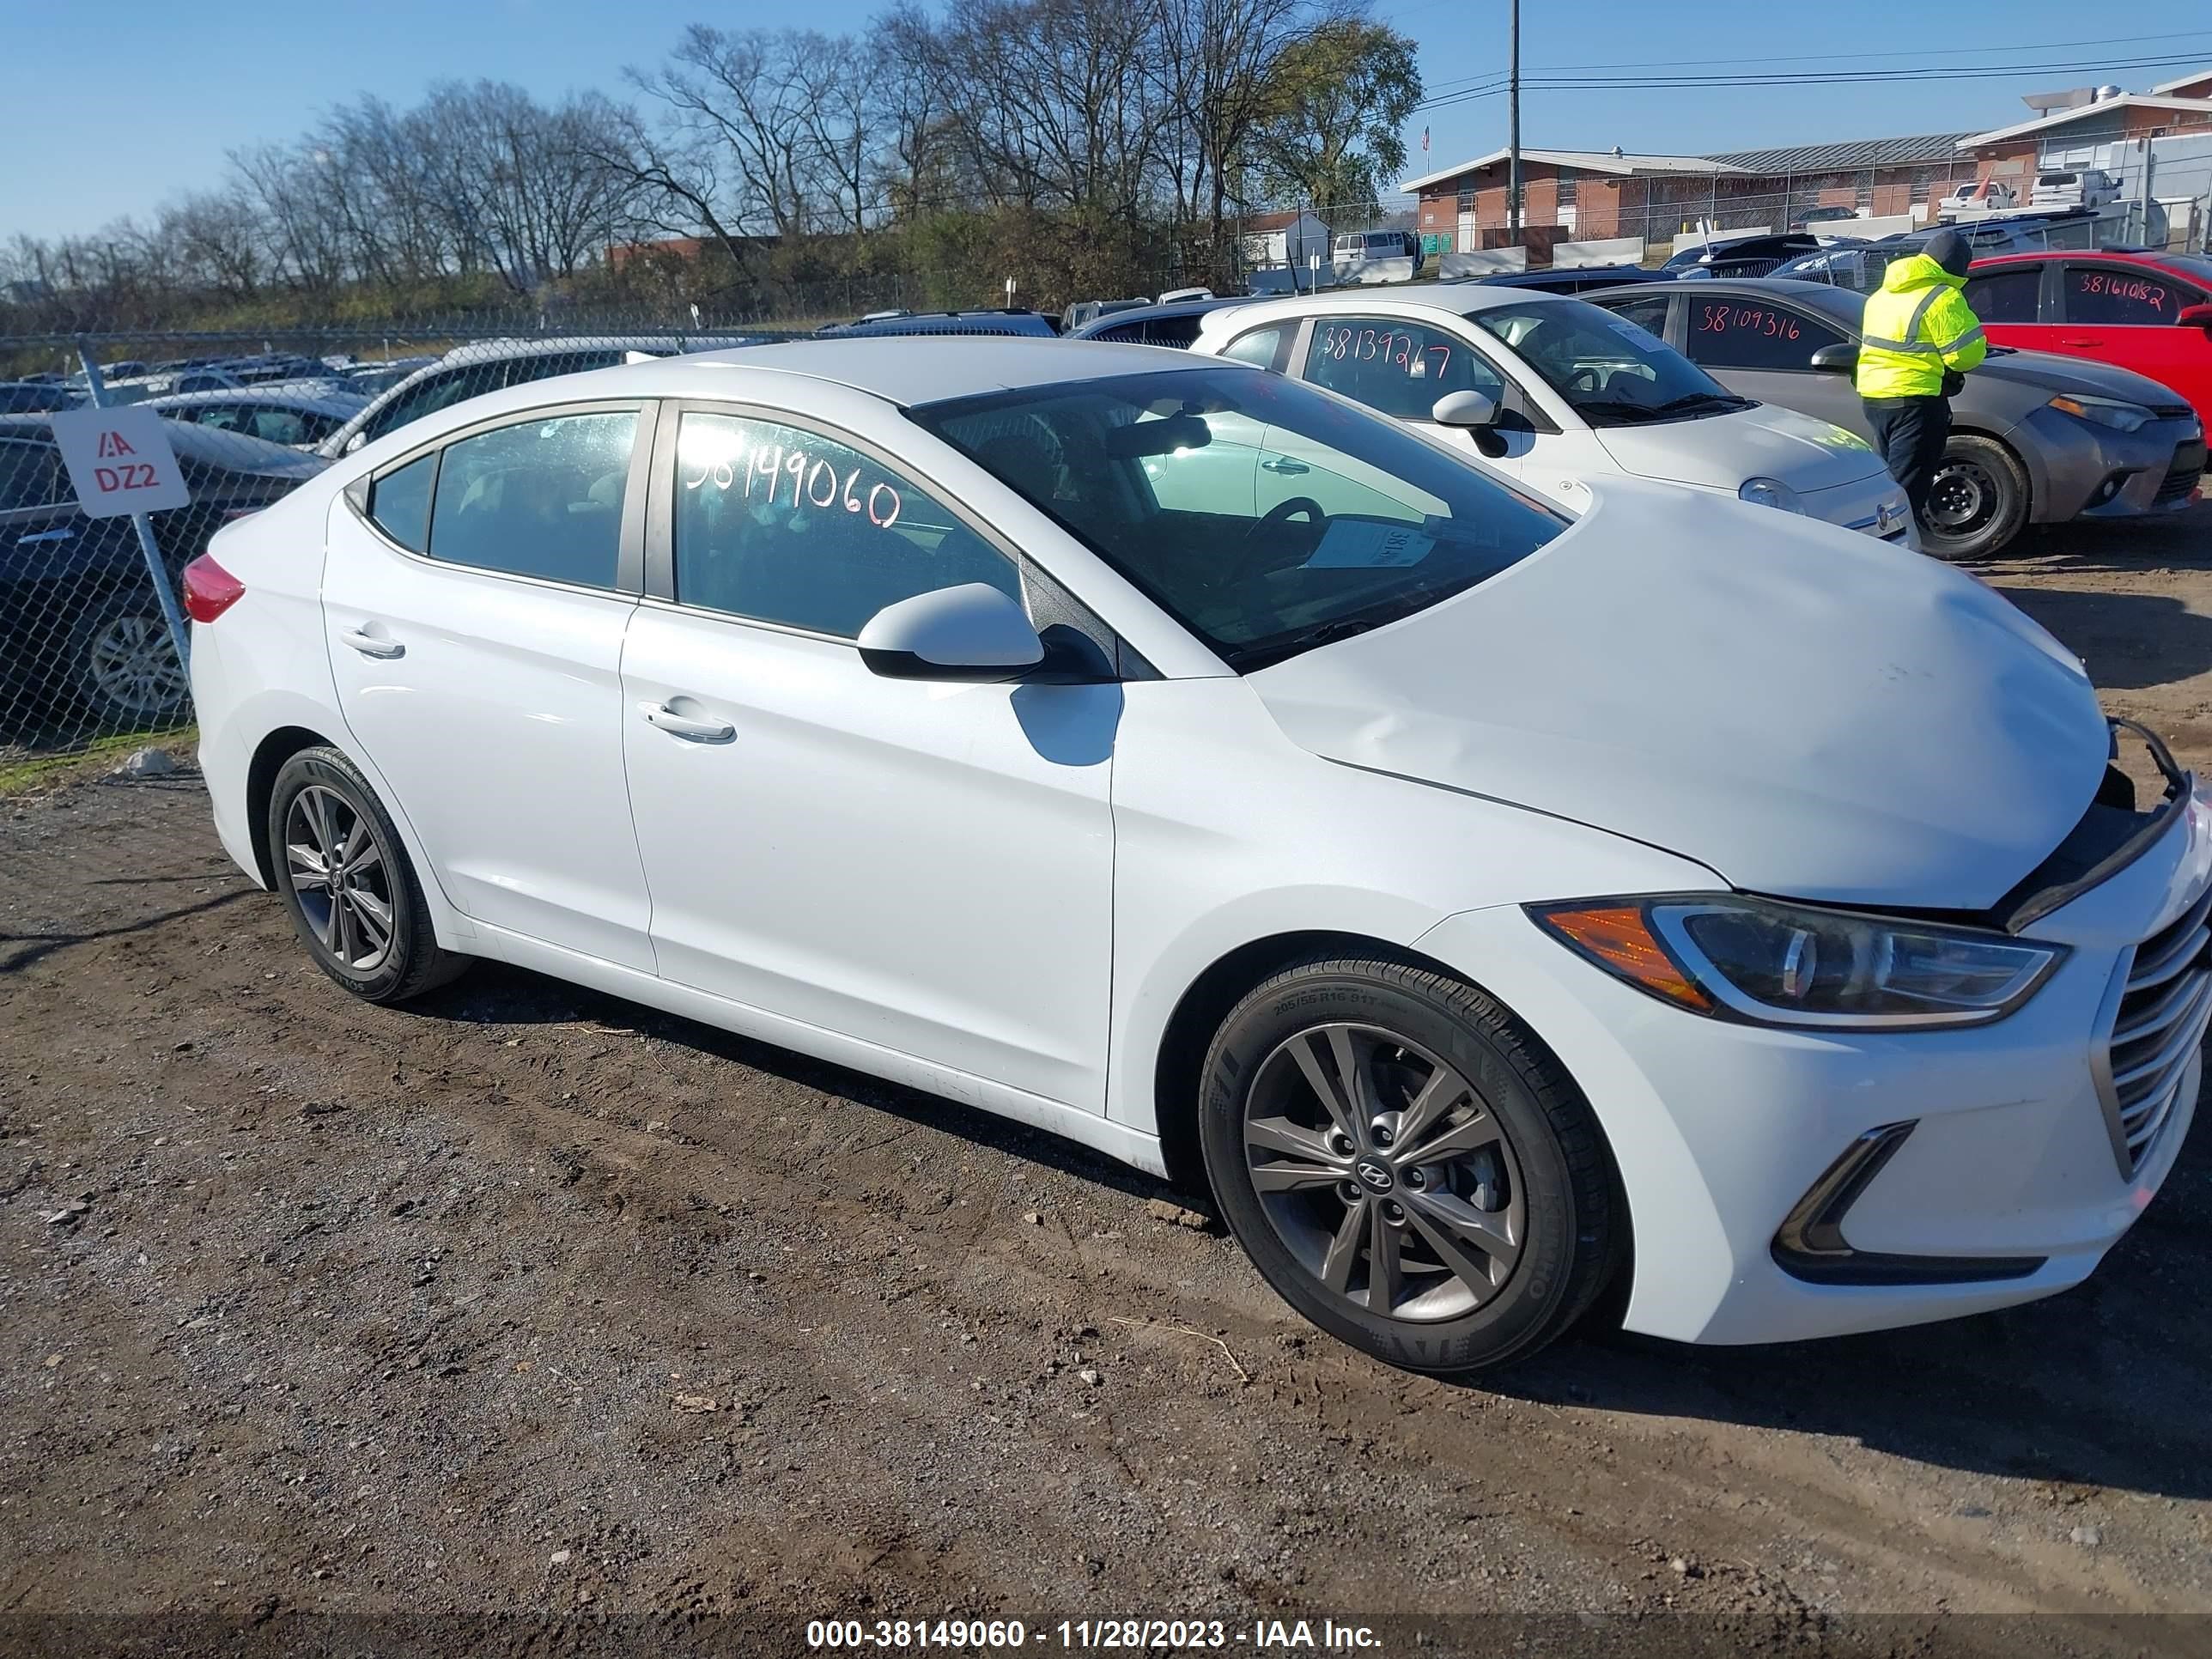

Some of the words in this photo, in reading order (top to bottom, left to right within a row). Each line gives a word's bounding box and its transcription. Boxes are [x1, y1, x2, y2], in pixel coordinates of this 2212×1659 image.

[1698, 306, 1800, 340] 38109316
[1323, 326, 1450, 380] 38139267
[94, 464, 161, 493] DZ2
[1320, 992, 1346, 1003] R16
